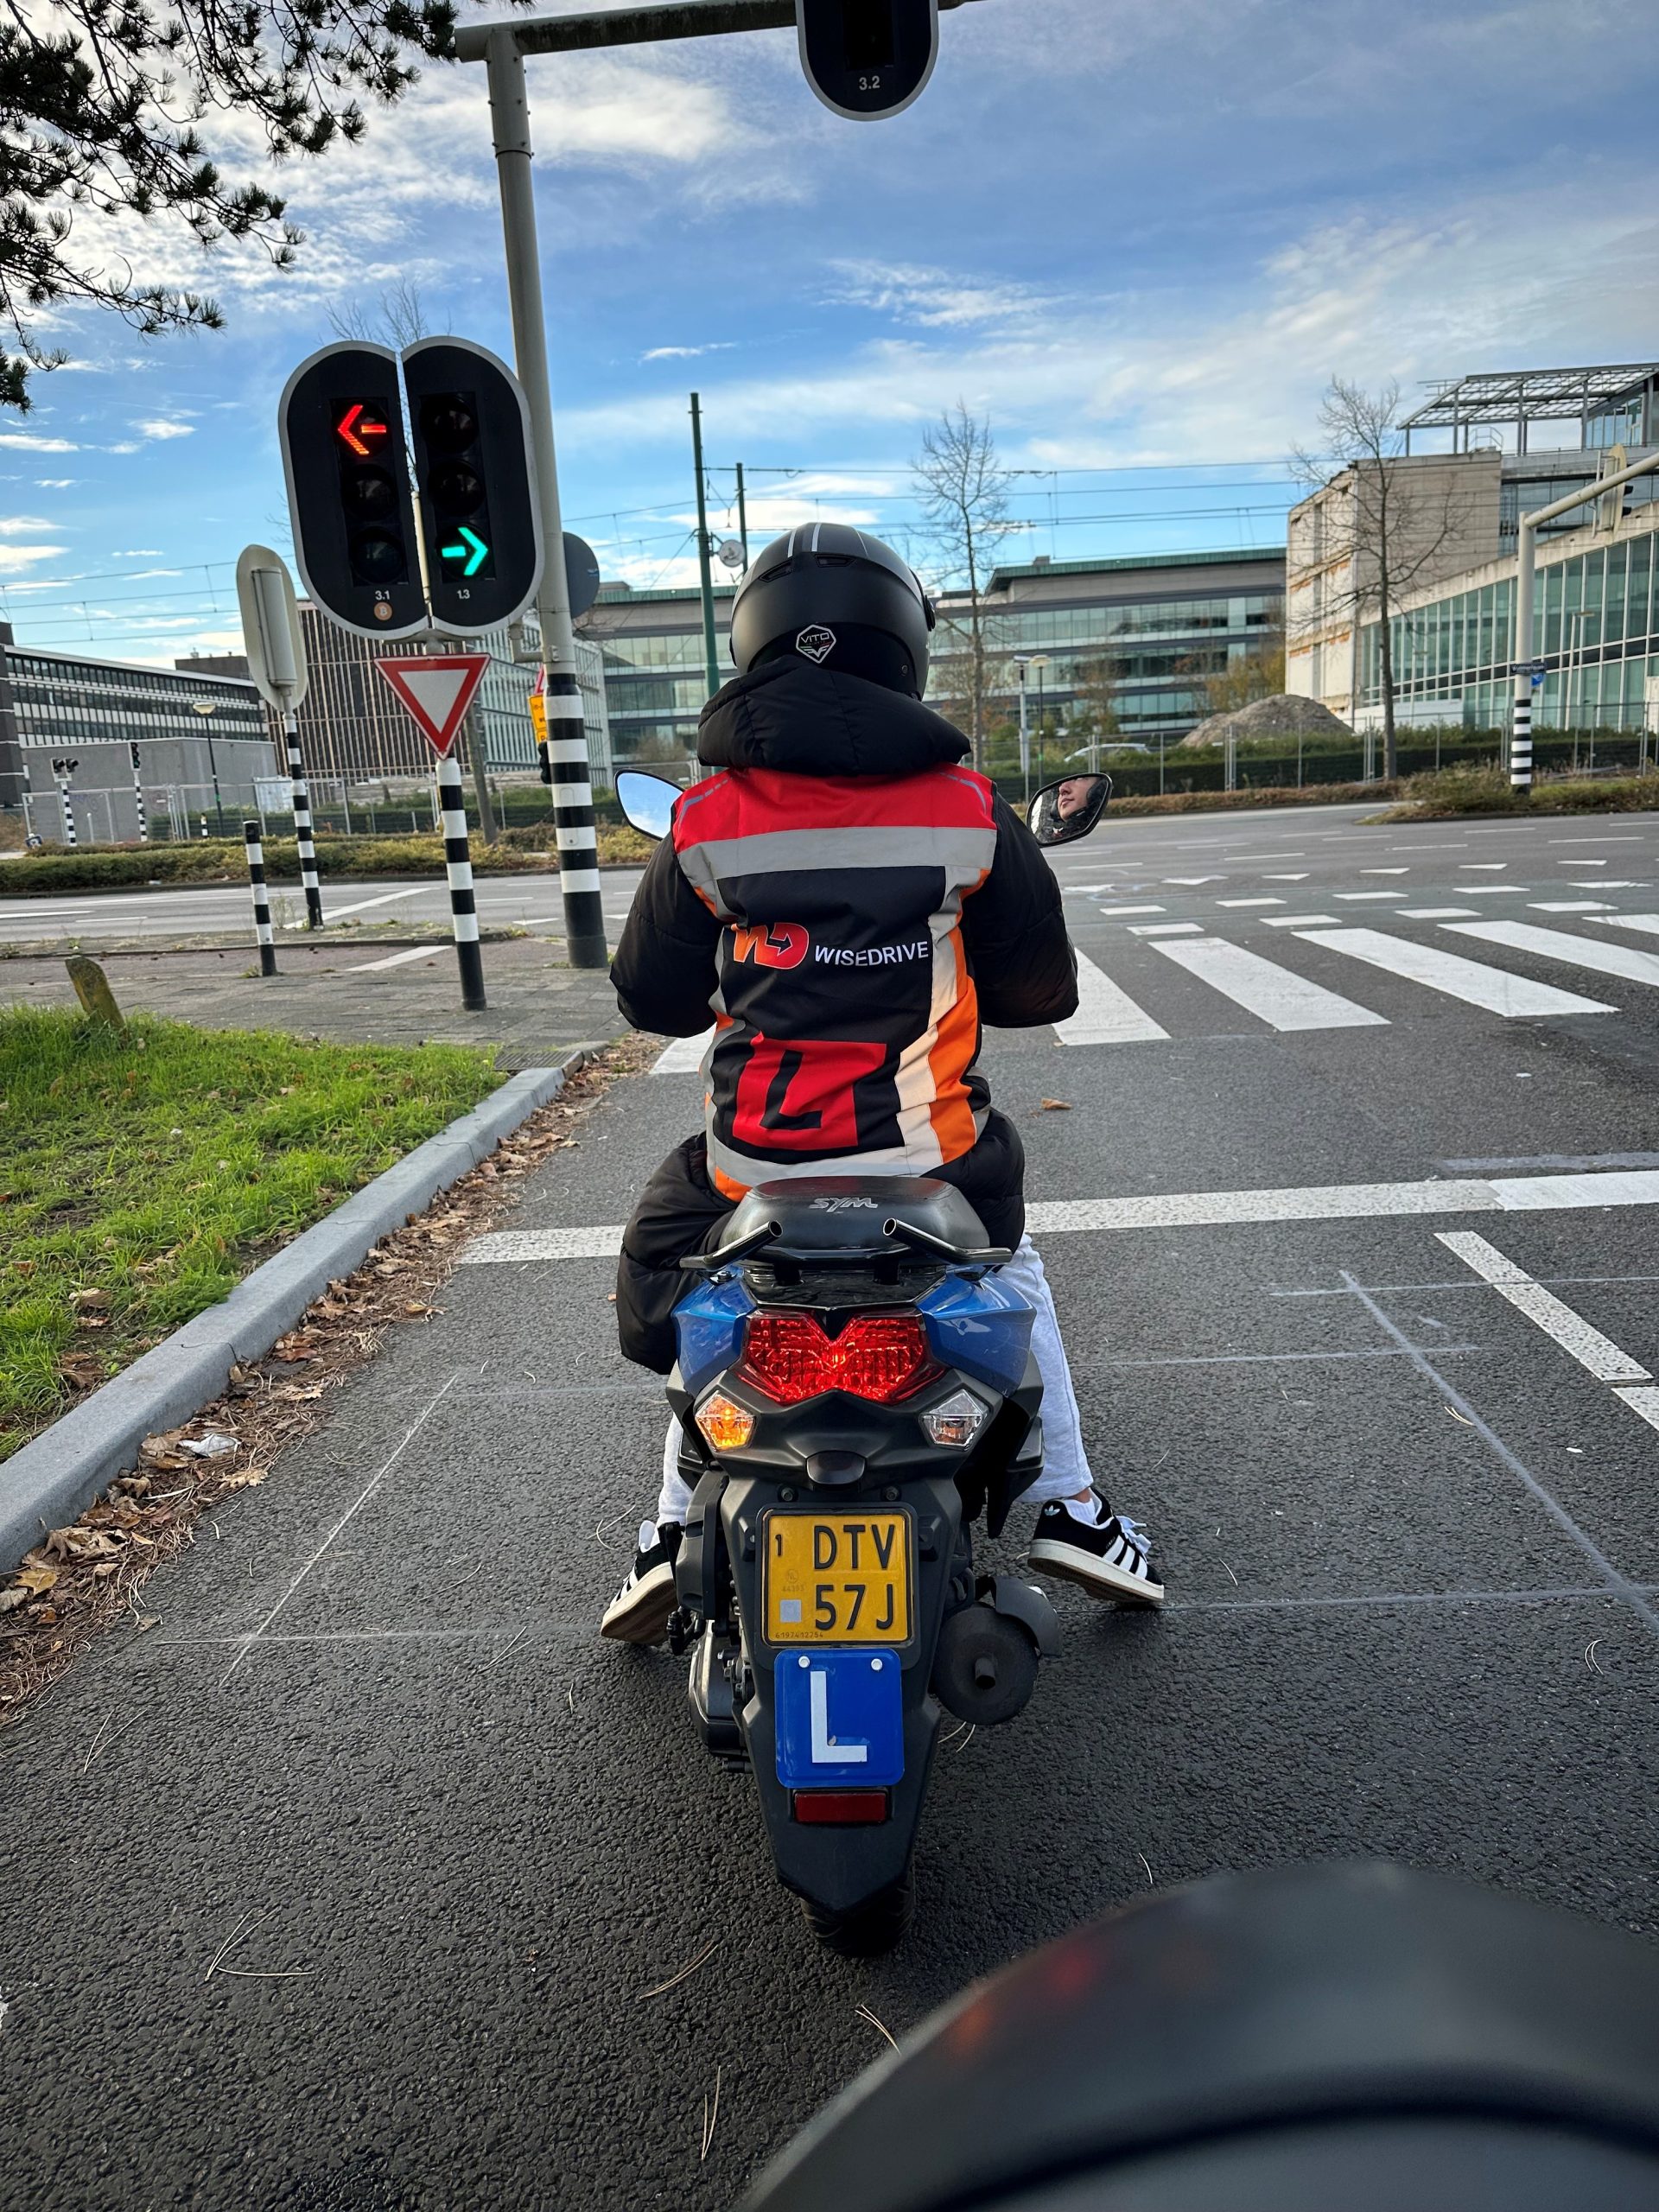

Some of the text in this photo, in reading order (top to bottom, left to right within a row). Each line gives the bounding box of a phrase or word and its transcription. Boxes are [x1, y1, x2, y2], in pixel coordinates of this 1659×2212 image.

[859, 75, 880, 91] 3.2
[375, 590, 391, 601] 3.1
[457, 589, 471, 600] 1.3
[800, 632, 830, 643] VITO
[815, 941, 929, 967] WISEDRIVE
[760, 1049, 823, 1131] L
[808, 1197, 879, 1213] SYM
[774, 1534, 783, 1558] 1
[814, 1524, 895, 1570] DTV
[815, 1583, 895, 1631] 57J
[810, 1670, 868, 1764] L
